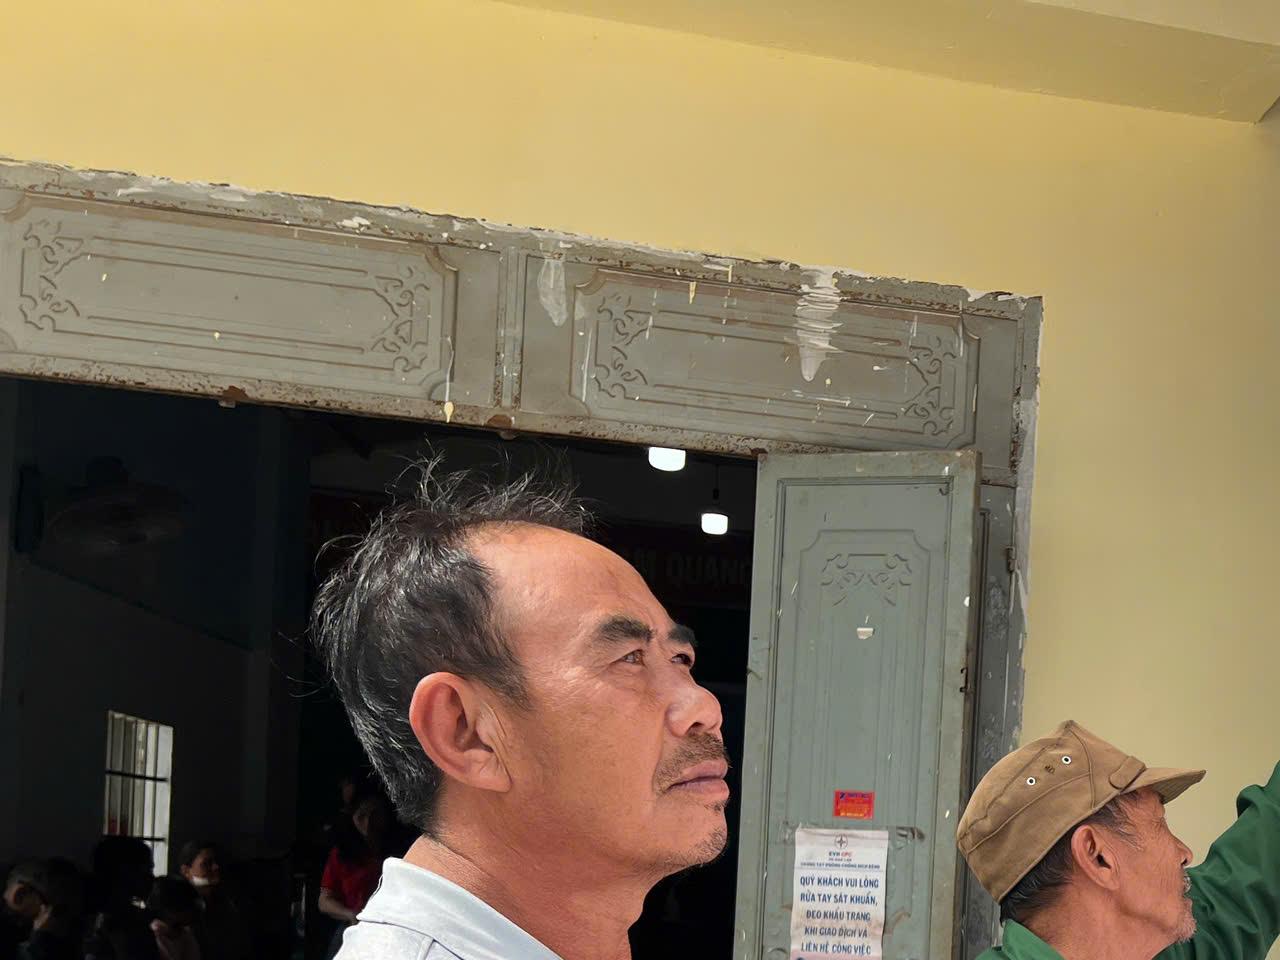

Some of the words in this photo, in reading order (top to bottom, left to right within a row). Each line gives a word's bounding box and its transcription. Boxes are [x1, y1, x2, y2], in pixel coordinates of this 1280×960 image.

[800, 874, 815, 886] QUÝ
[817, 875, 843, 887] KHÁCH
[845, 877, 857, 887] VUI
[859, 876, 879, 888] LÒNG
[800, 891, 816, 902] RỬA
[818, 892, 831, 903] TAY
[834, 893, 848, 904] SÁT
[850, 891, 878, 906] KHUẨN,
[806, 910, 822, 920] ĐEO
[823, 906, 844, 920] KHẨU
[846, 912, 870, 922] TRANG
[804, 926, 818, 936] KHI
[819, 928, 837, 937] GIAO
[838, 928, 856, 939] DỊCH
[858, 927, 868, 938] VÀ
[801, 942, 818, 952] LIÊN
[819, 942, 830, 954] HỆ
[832, 942, 852, 954] CÔNG
[854, 943, 871, 955] VIỆC
